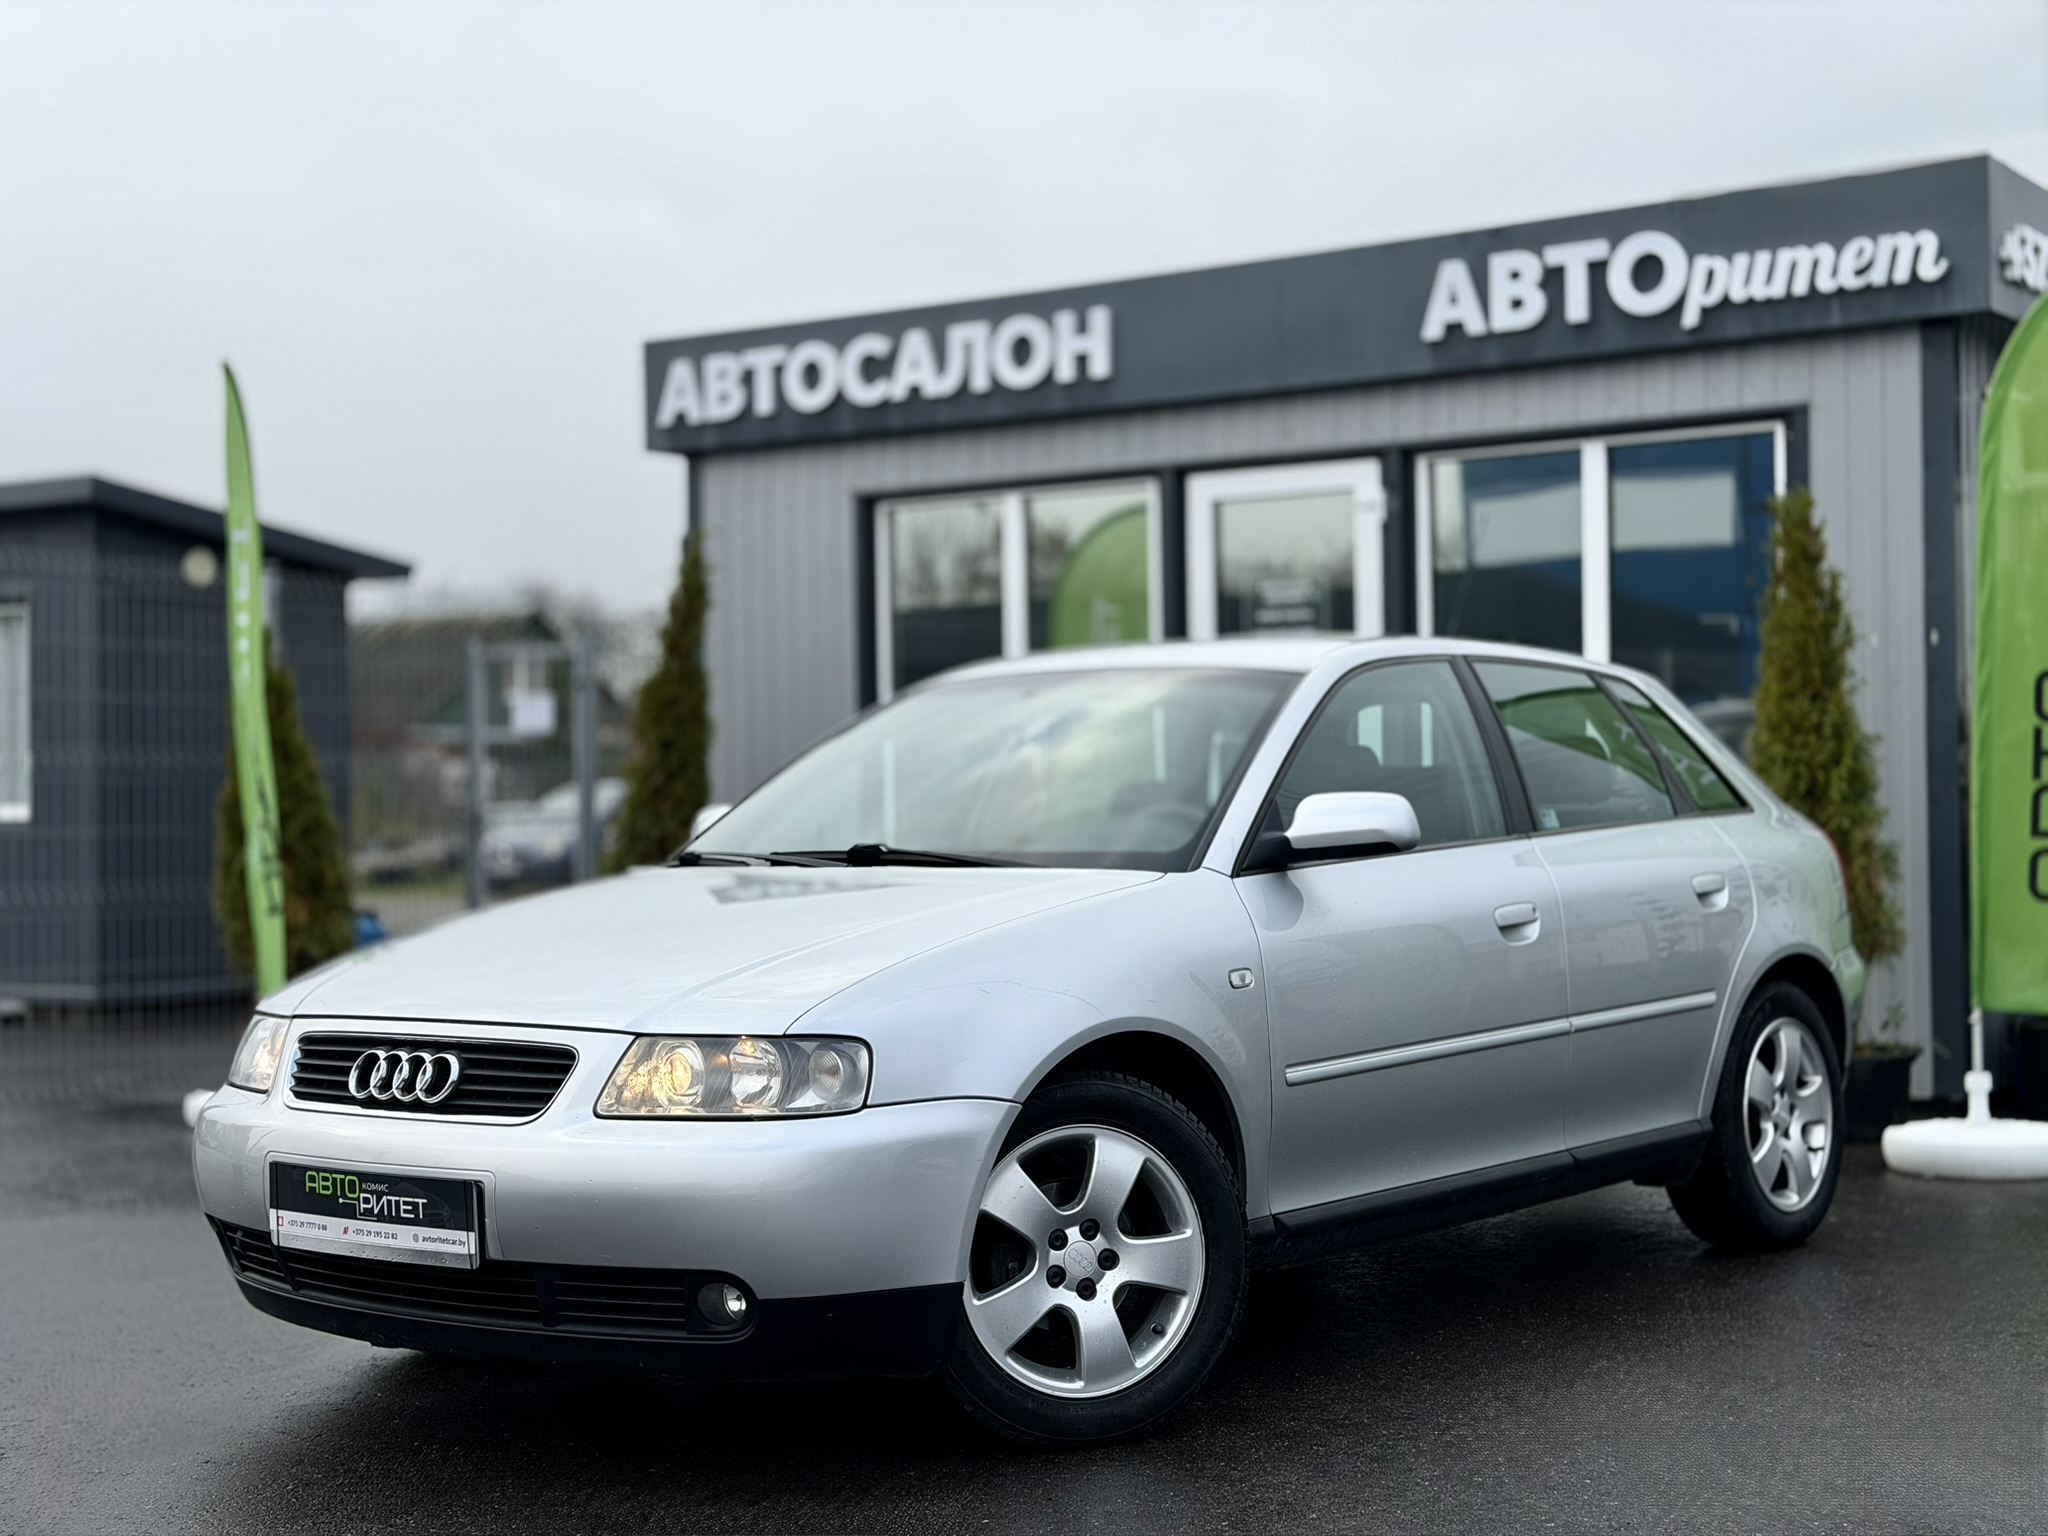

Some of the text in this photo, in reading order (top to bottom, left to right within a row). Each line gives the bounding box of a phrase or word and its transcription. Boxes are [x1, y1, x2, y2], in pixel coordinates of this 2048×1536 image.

[1420, 229, 1948, 343] АВТОритет
[655, 304, 1112, 429] АВТОСАЛОН
[305, 1170, 360, 1198] АВТО
[360, 1193, 428, 1219] РИТЕТ
[352, 1228, 365, 1237] +375
[365, 1229, 372, 1237] 29
[373, 1230, 383, 1238] 195
[383, 1231, 390, 1239] 22
[421, 1235, 466, 1248] avtoritetcar.by
